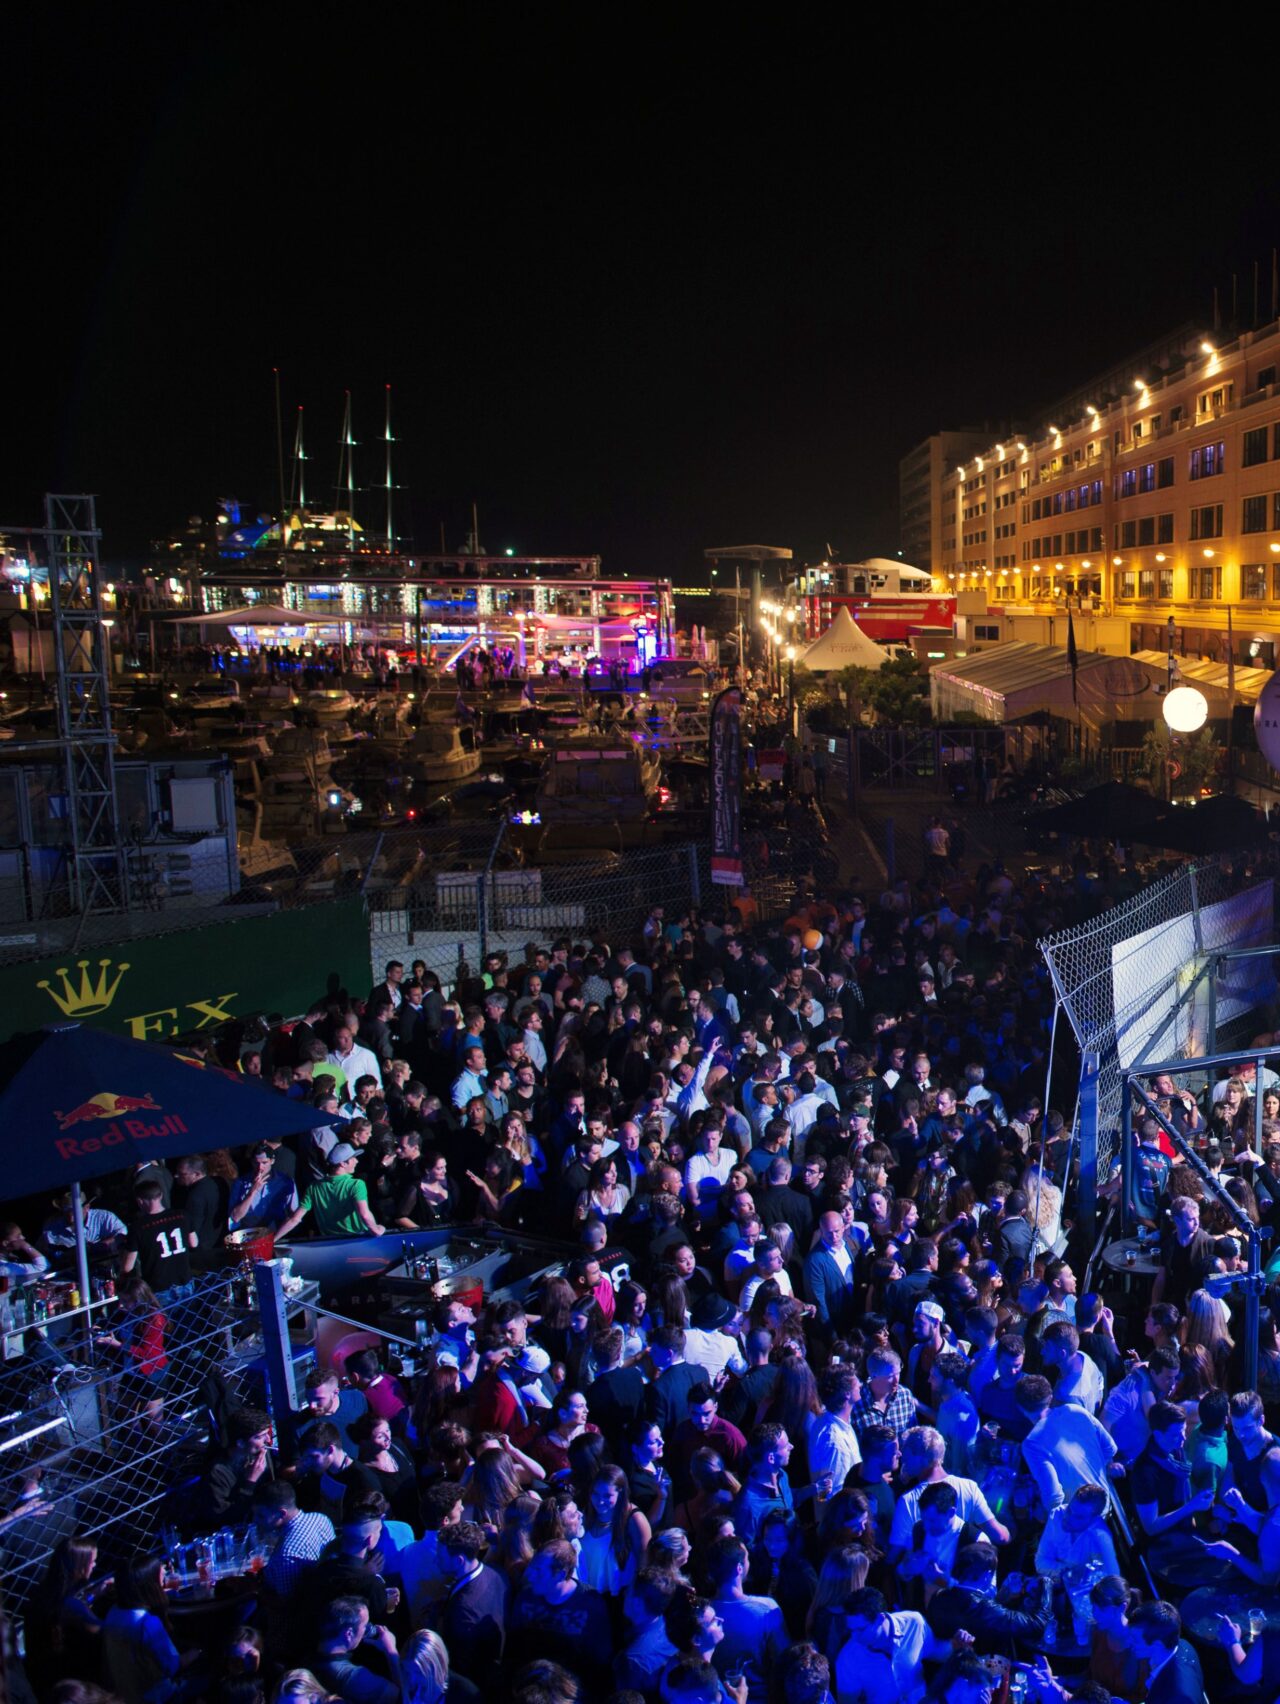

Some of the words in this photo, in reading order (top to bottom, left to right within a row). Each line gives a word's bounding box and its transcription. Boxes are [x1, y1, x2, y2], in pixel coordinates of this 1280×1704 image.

[54, 1122, 126, 1161] Red
[123, 1113, 189, 1139] Bull
[156, 1227, 187, 1258] 11
